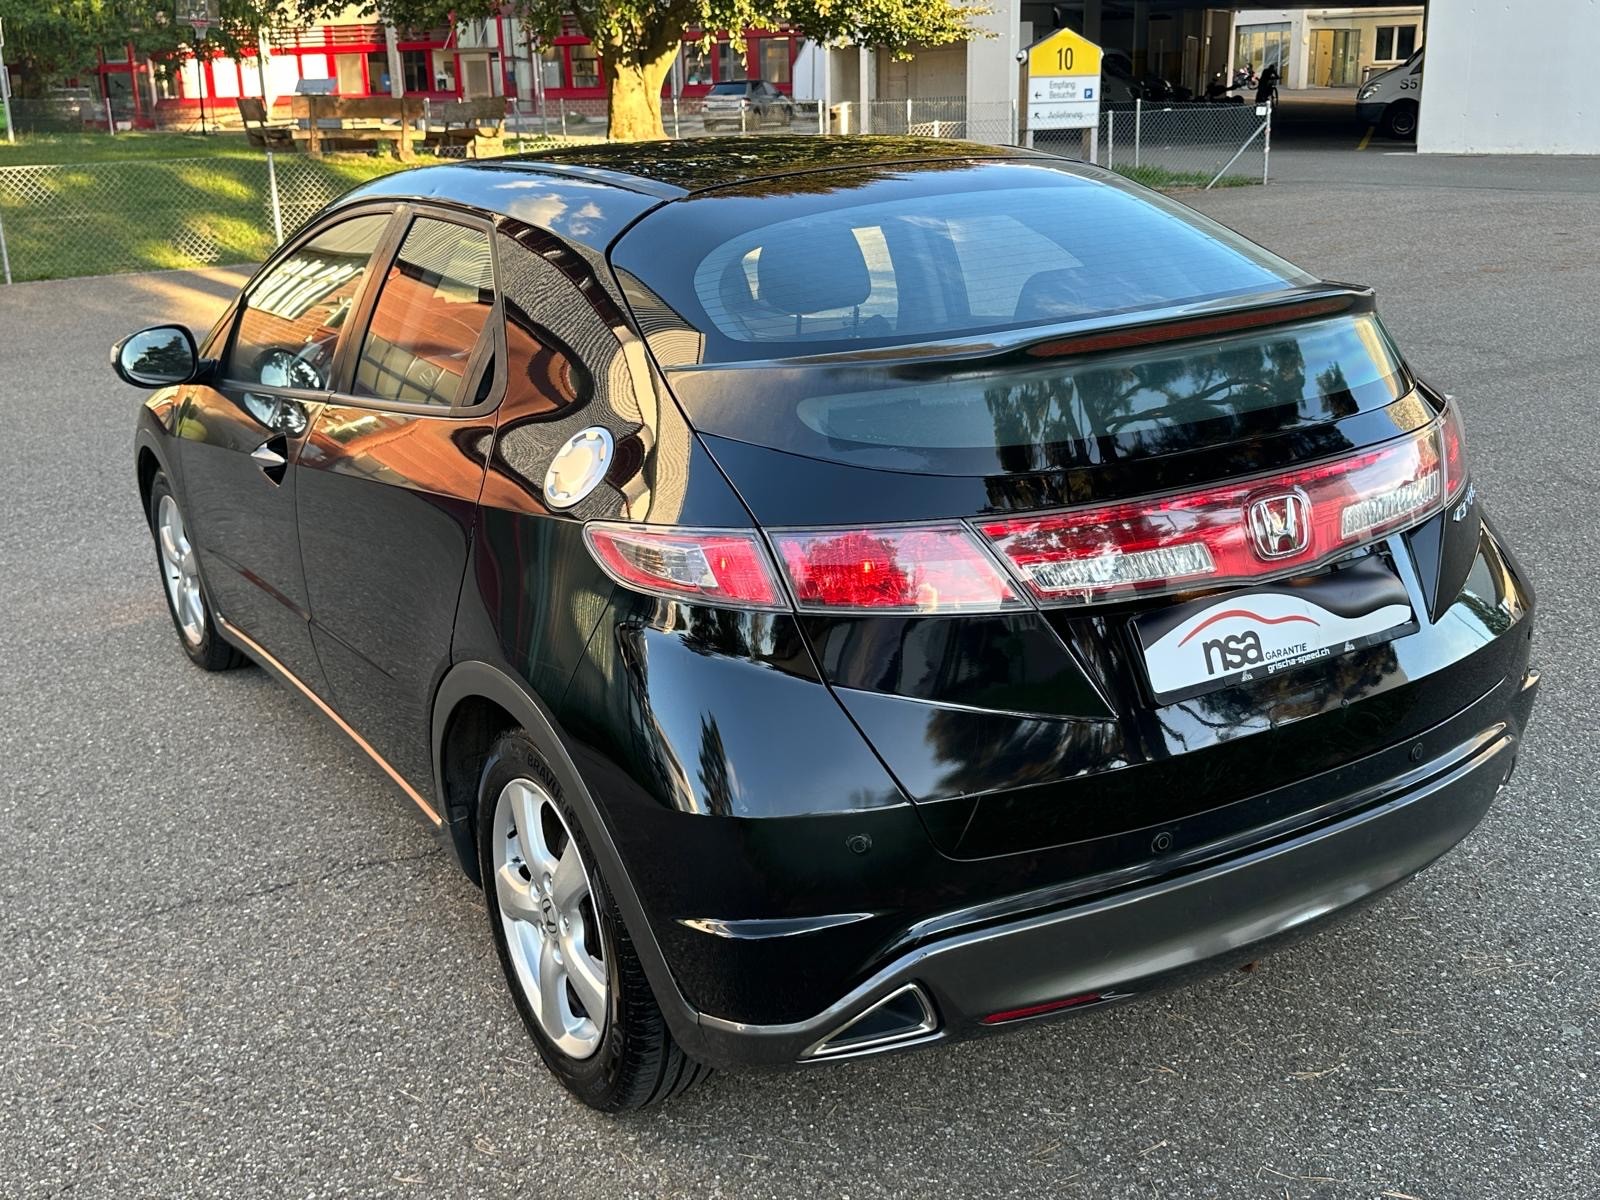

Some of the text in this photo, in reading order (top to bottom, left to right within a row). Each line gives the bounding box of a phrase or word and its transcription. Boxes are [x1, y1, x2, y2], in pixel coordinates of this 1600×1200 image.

[1057, 47, 1074, 70] 10
[1049, 80, 1076, 90] Empfang
[1400, 79, 1418, 90] S5
[1049, 90, 1077, 99] Besucher
[1202, 630, 1264, 675] nsa
[1265, 642, 1308, 660] GARANTIE
[1267, 648, 1331, 674] grischa-speed.ch
